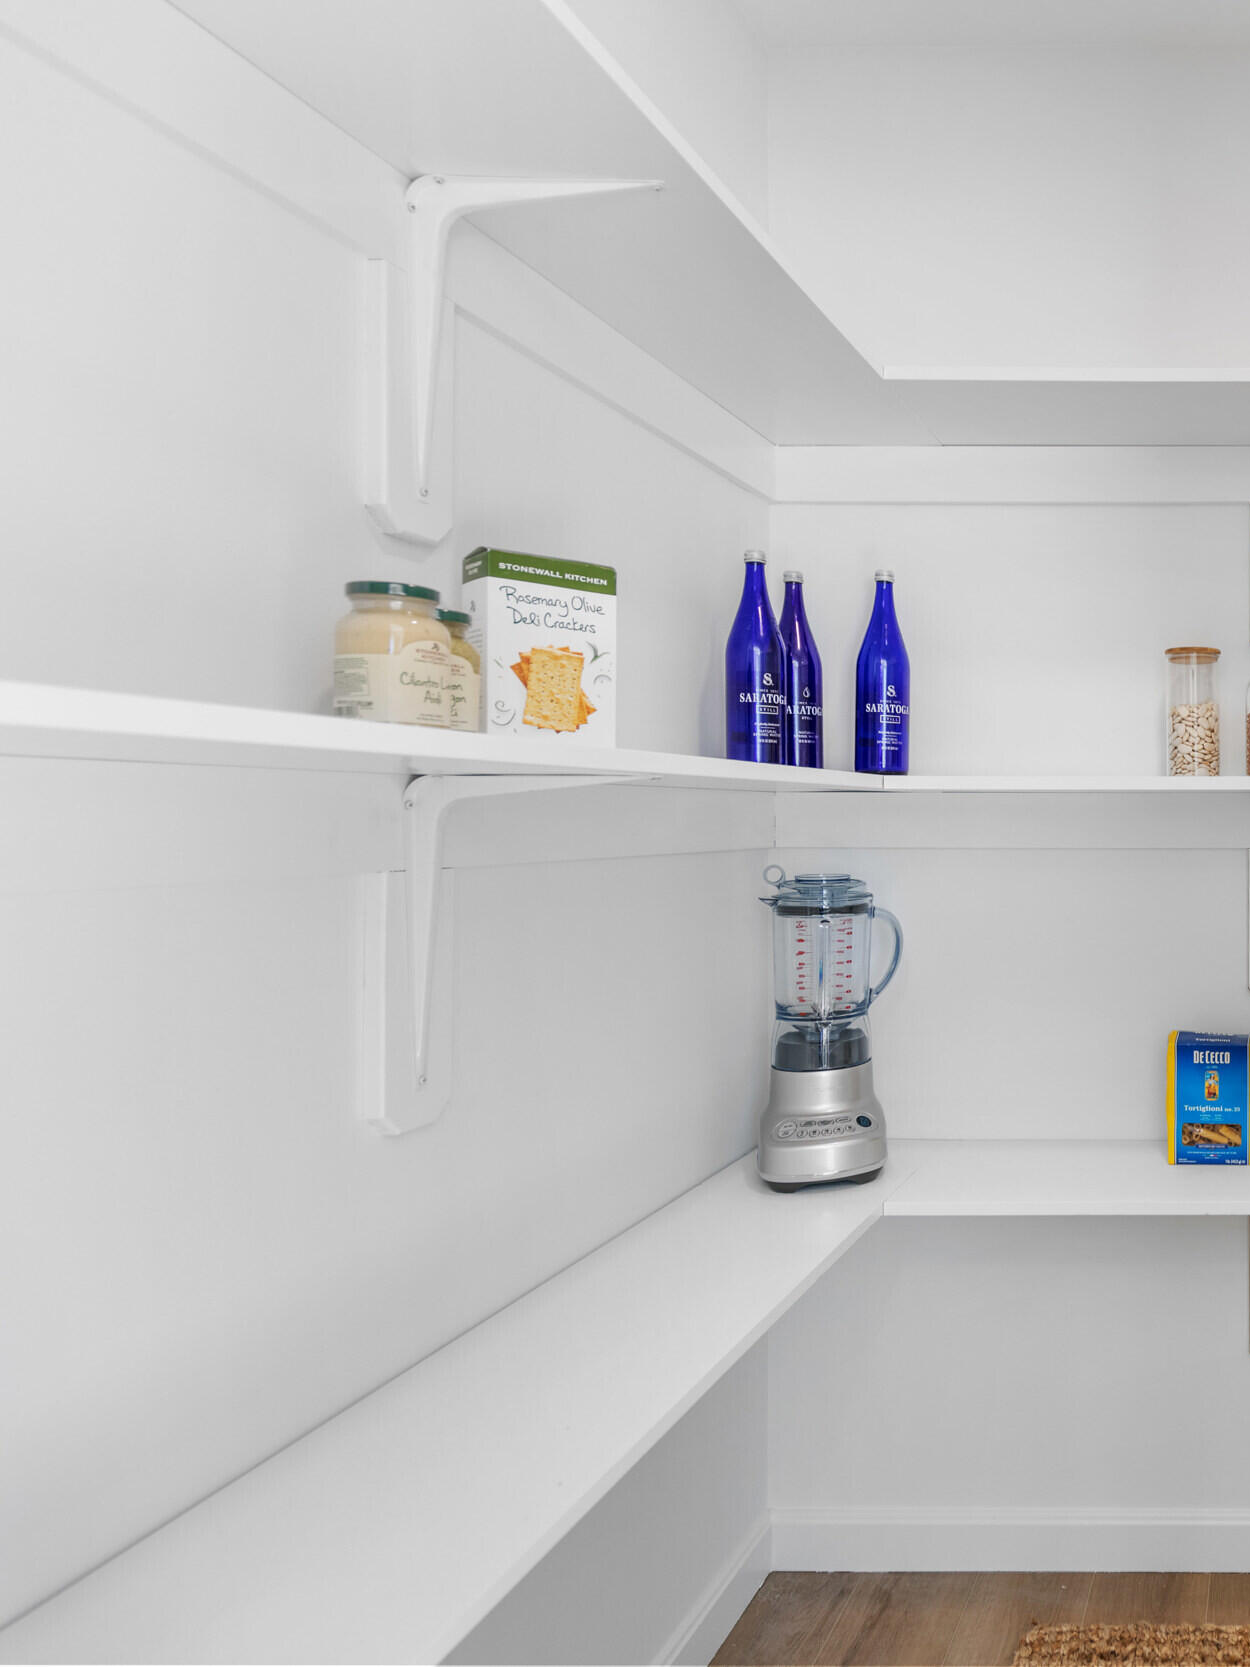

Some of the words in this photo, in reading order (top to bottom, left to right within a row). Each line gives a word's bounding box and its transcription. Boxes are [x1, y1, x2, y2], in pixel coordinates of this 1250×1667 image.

[498, 561, 563, 579] STONEWALL
[564, 573, 608, 586] KITCHEN
[499, 585, 569, 617] Rosemary
[571, 595, 606, 615] Olive
[506, 606, 541, 626] Deli
[543, 612, 597, 634] Crackers
[739, 692, 787, 705] SARATOG
[1205, 1050, 1231, 1064] CECCO
[1184, 1104, 1223, 1112] Tortiglioni
